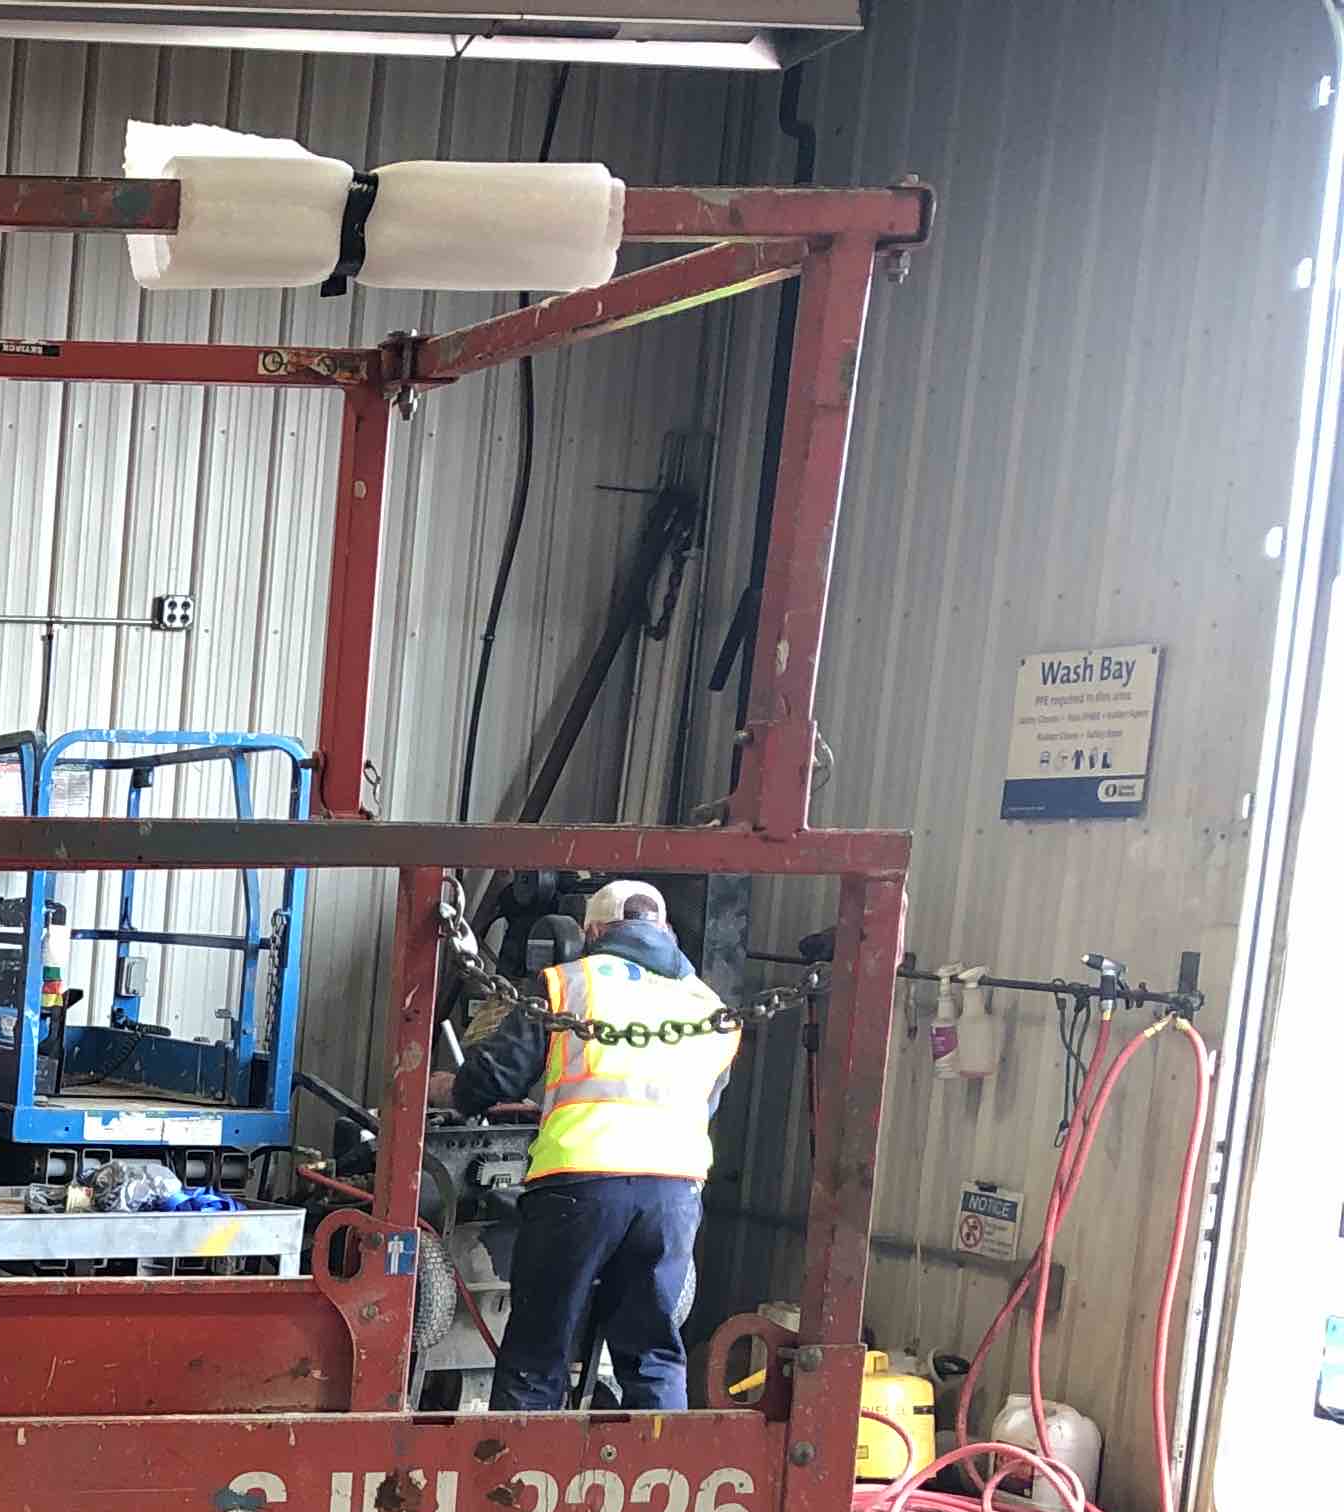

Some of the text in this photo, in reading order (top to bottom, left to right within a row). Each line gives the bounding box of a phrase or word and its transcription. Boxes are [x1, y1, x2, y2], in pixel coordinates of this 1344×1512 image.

[1041, 655, 1136, 687] Wash Bay
[968, 1198, 1012, 1218] NOTICE
